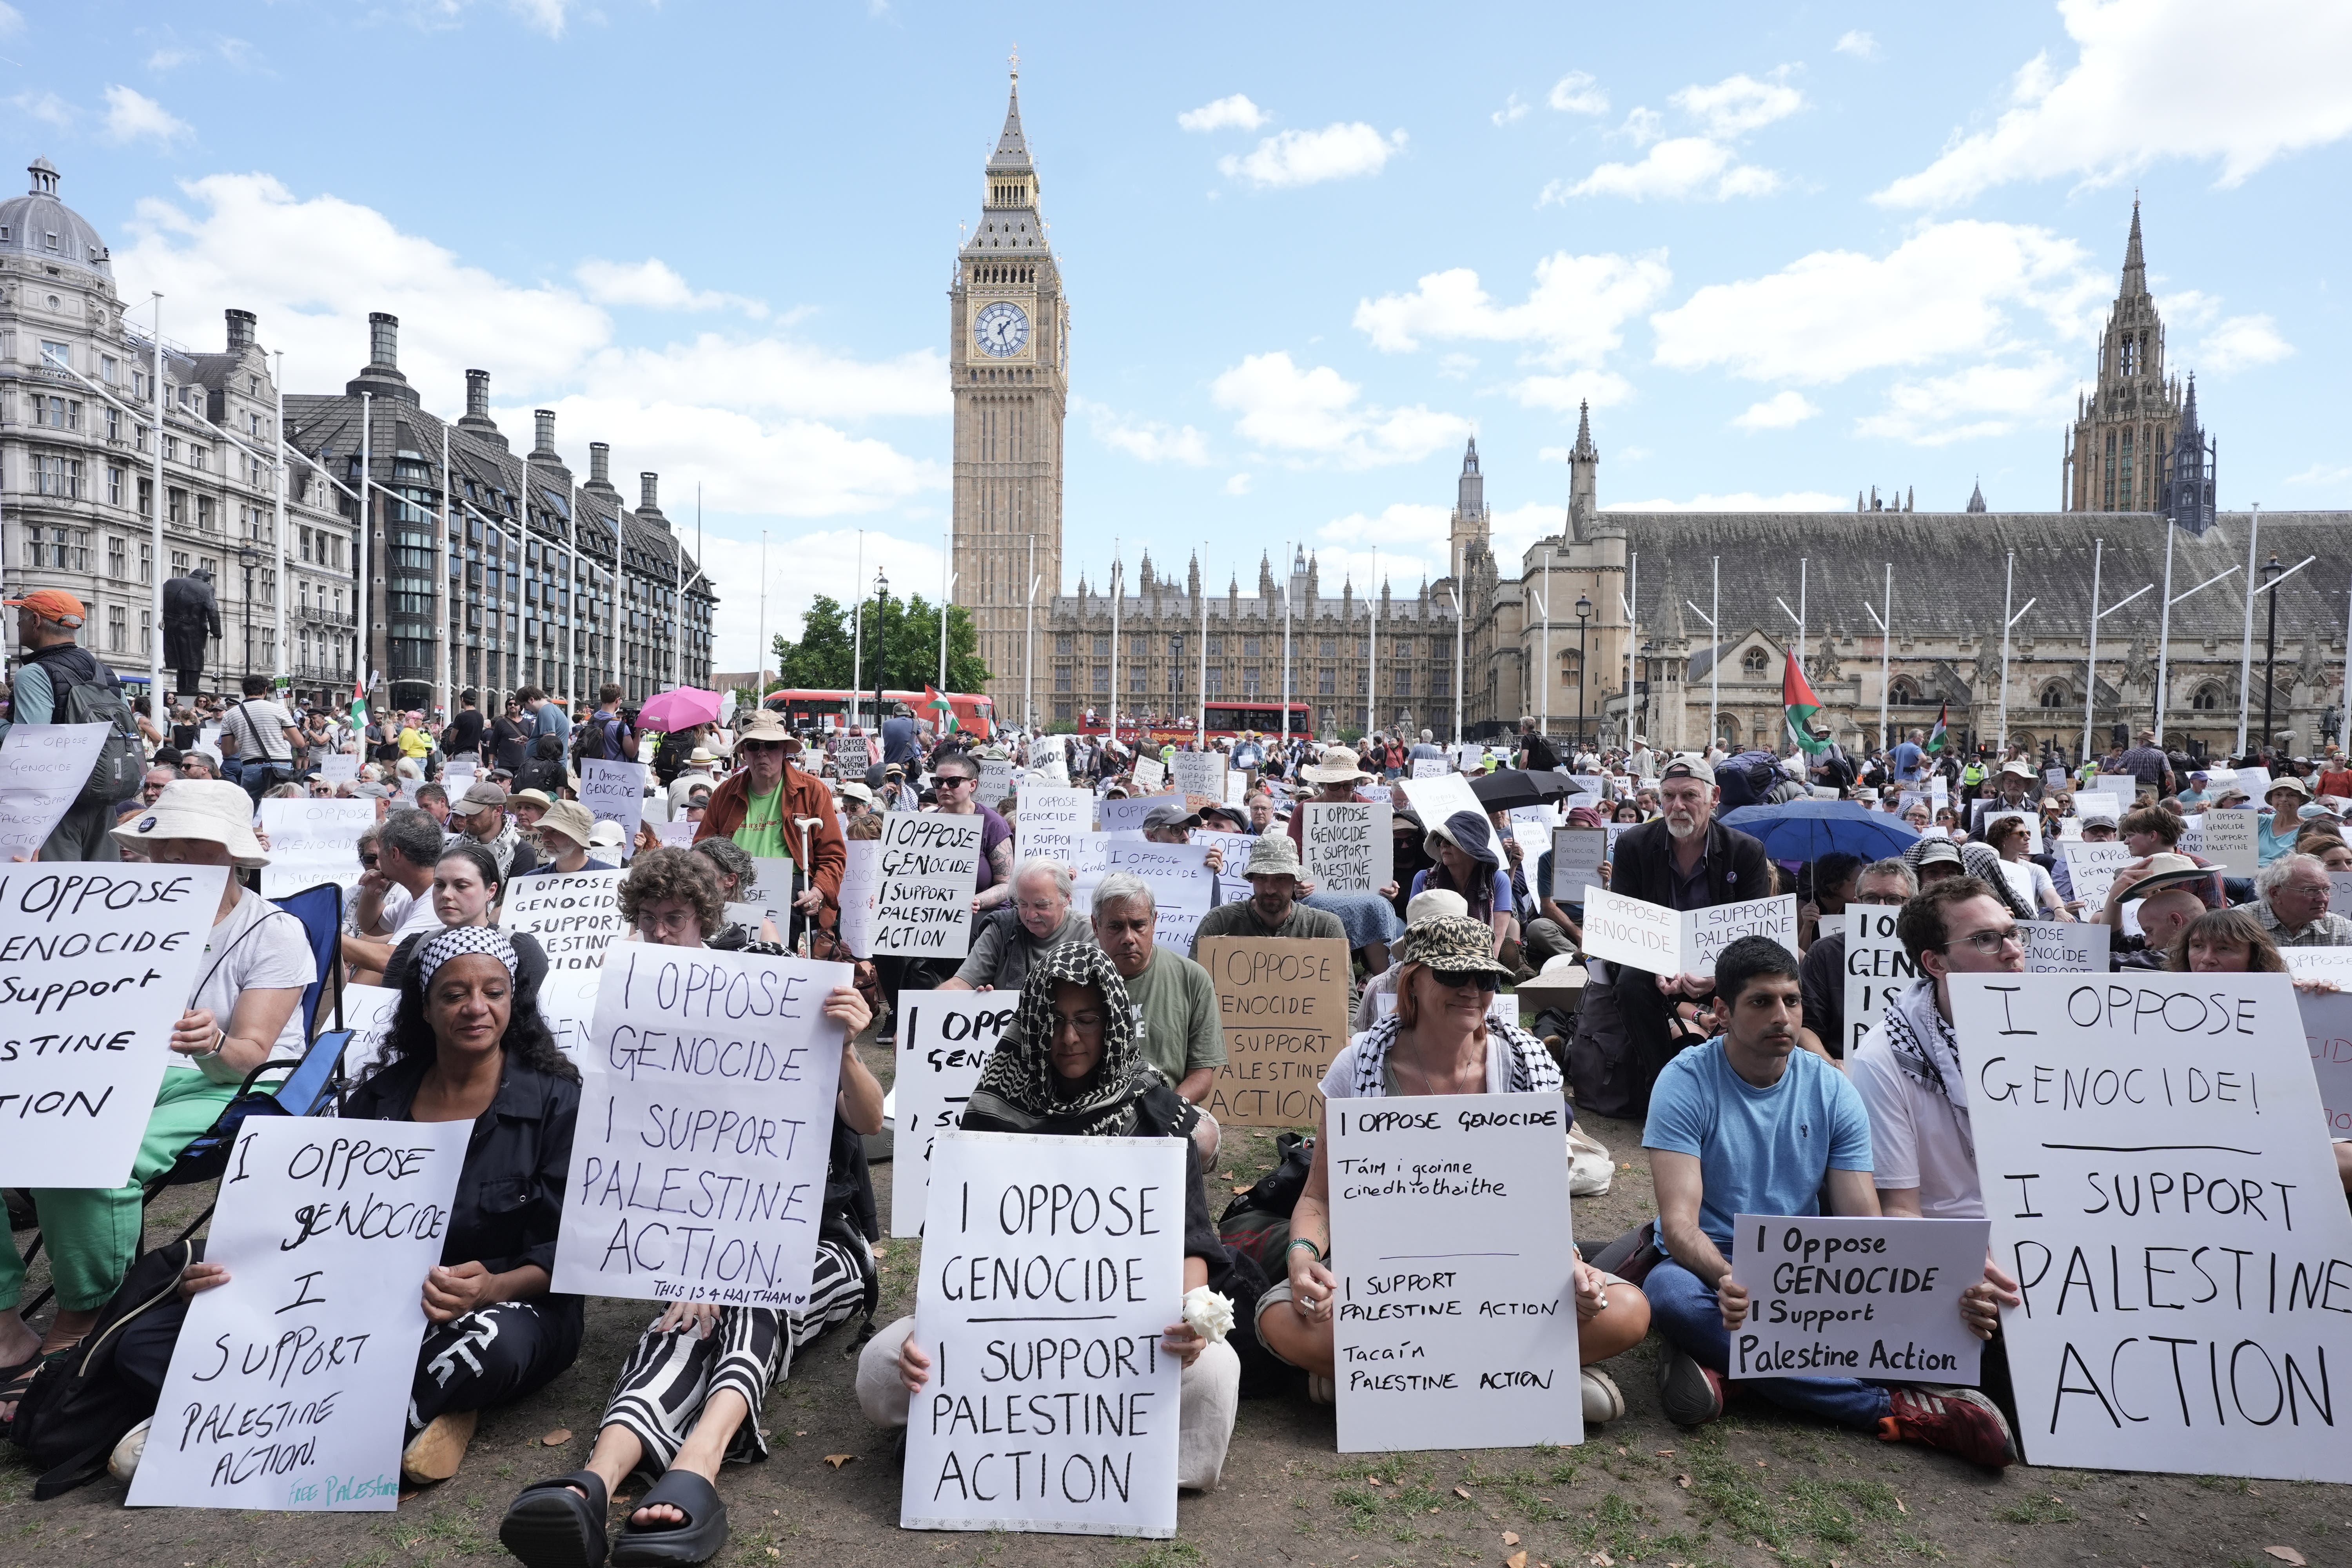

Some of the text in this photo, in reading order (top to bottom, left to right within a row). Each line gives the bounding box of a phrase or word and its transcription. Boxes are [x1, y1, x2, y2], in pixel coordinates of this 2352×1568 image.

[15, 734, 31, 748] I
[589, 768, 592, 780] I
[1033, 752, 1066, 768] GENOCI
[586, 783, 635, 797] GENOCIDE
[1178, 772, 1223, 782] SUPPORT
[307, 808, 371, 820] OPPOSE
[593, 810, 625, 822] SUPPORT
[1039, 797, 1078, 807] OPPOSE
[1313, 806, 1370, 824] I OPPOSE
[1020, 813, 1076, 821] GENOCIDE
[886, 818, 980, 848] I OPPOSE
[1311, 825, 1371, 844] GENOCIDE
[882, 850, 975, 877] GENOCIDE
[1111, 851, 1182, 864] I OPPOSE
[1309, 845, 1372, 861] I SUPPORT
[1312, 859, 1372, 880] PALESTINE
[1327, 876, 1370, 891] ACTION
[21, 876, 192, 922] OPPOSE
[516, 878, 613, 895] I OPPOSE
[879, 881, 958, 904] I SUPPORT
[515, 895, 615, 911] GENOCID
[878, 906, 966, 923] PALESTINE
[1607, 900, 1671, 926] OPPOSE
[1709, 897, 1793, 925] SUPPORT
[528, 915, 623, 934] SUPPORT
[875, 926, 946, 949] ACTION
[1583, 915, 1674, 954] GENOCIDE
[0, 932, 190, 962] ENOCIDE
[1228, 951, 1330, 985] OPPOSE
[625, 953, 807, 1019] I OPPOSE
[1222, 995, 1316, 1014] ENOCIDE
[1984, 985, 2256, 1035] I OPPOSE
[907, 1007, 1016, 1050] I OPP
[0, 1031, 136, 1061] STINE
[610, 1025, 808, 1081] GENOCIDE
[1235, 1034, 1331, 1053] SUPPORT
[1220, 1062, 1328, 1081] ALESTINE
[1981, 1056, 2260, 1115] GENOCIDE!
[0, 1086, 113, 1118] TION
[606, 1096, 806, 1160] I SUPPORT
[1341, 1111, 1557, 1136] I OPPOSE GENOCIDE
[229, 1132, 435, 1190] I OPPOSE
[582, 1157, 810, 1223] PALESTINE
[2004, 1172, 2296, 1231] I SUPPORT
[962, 1181, 1160, 1236] I OPPOSE
[600, 1218, 782, 1289] ACTION.
[1758, 1225, 1886, 1263] I Oppose
[275, 1271, 325, 1314] I
[654, 1280, 684, 1297] THIS
[690, 1287, 704, 1300] IS
[723, 1289, 791, 1304] HAITHAM
[942, 1255, 1147, 1303] GENOCIDE
[1347, 1272, 1456, 1301] I SUPPORT
[1773, 1262, 1939, 1294] GENOCIDE
[2014, 1241, 2352, 1318] PALESTINE
[1340, 1300, 1559, 1321] PALESTINE ACTION
[1753, 1299, 1874, 1333] I Support
[192, 1326, 370, 1388] SUPPORT
[940, 1335, 1162, 1387] I SUPPORT
[1740, 1335, 1957, 1373] Palestine Action
[1350, 1370, 1553, 1391] PALESTINE ACTION
[2050, 1336, 2333, 1434] ACTION
[933, 1393, 1154, 1436] PALESTINE
[211, 1436, 315, 1487] ACTION.
[934, 1451, 1131, 1503] ACTION
